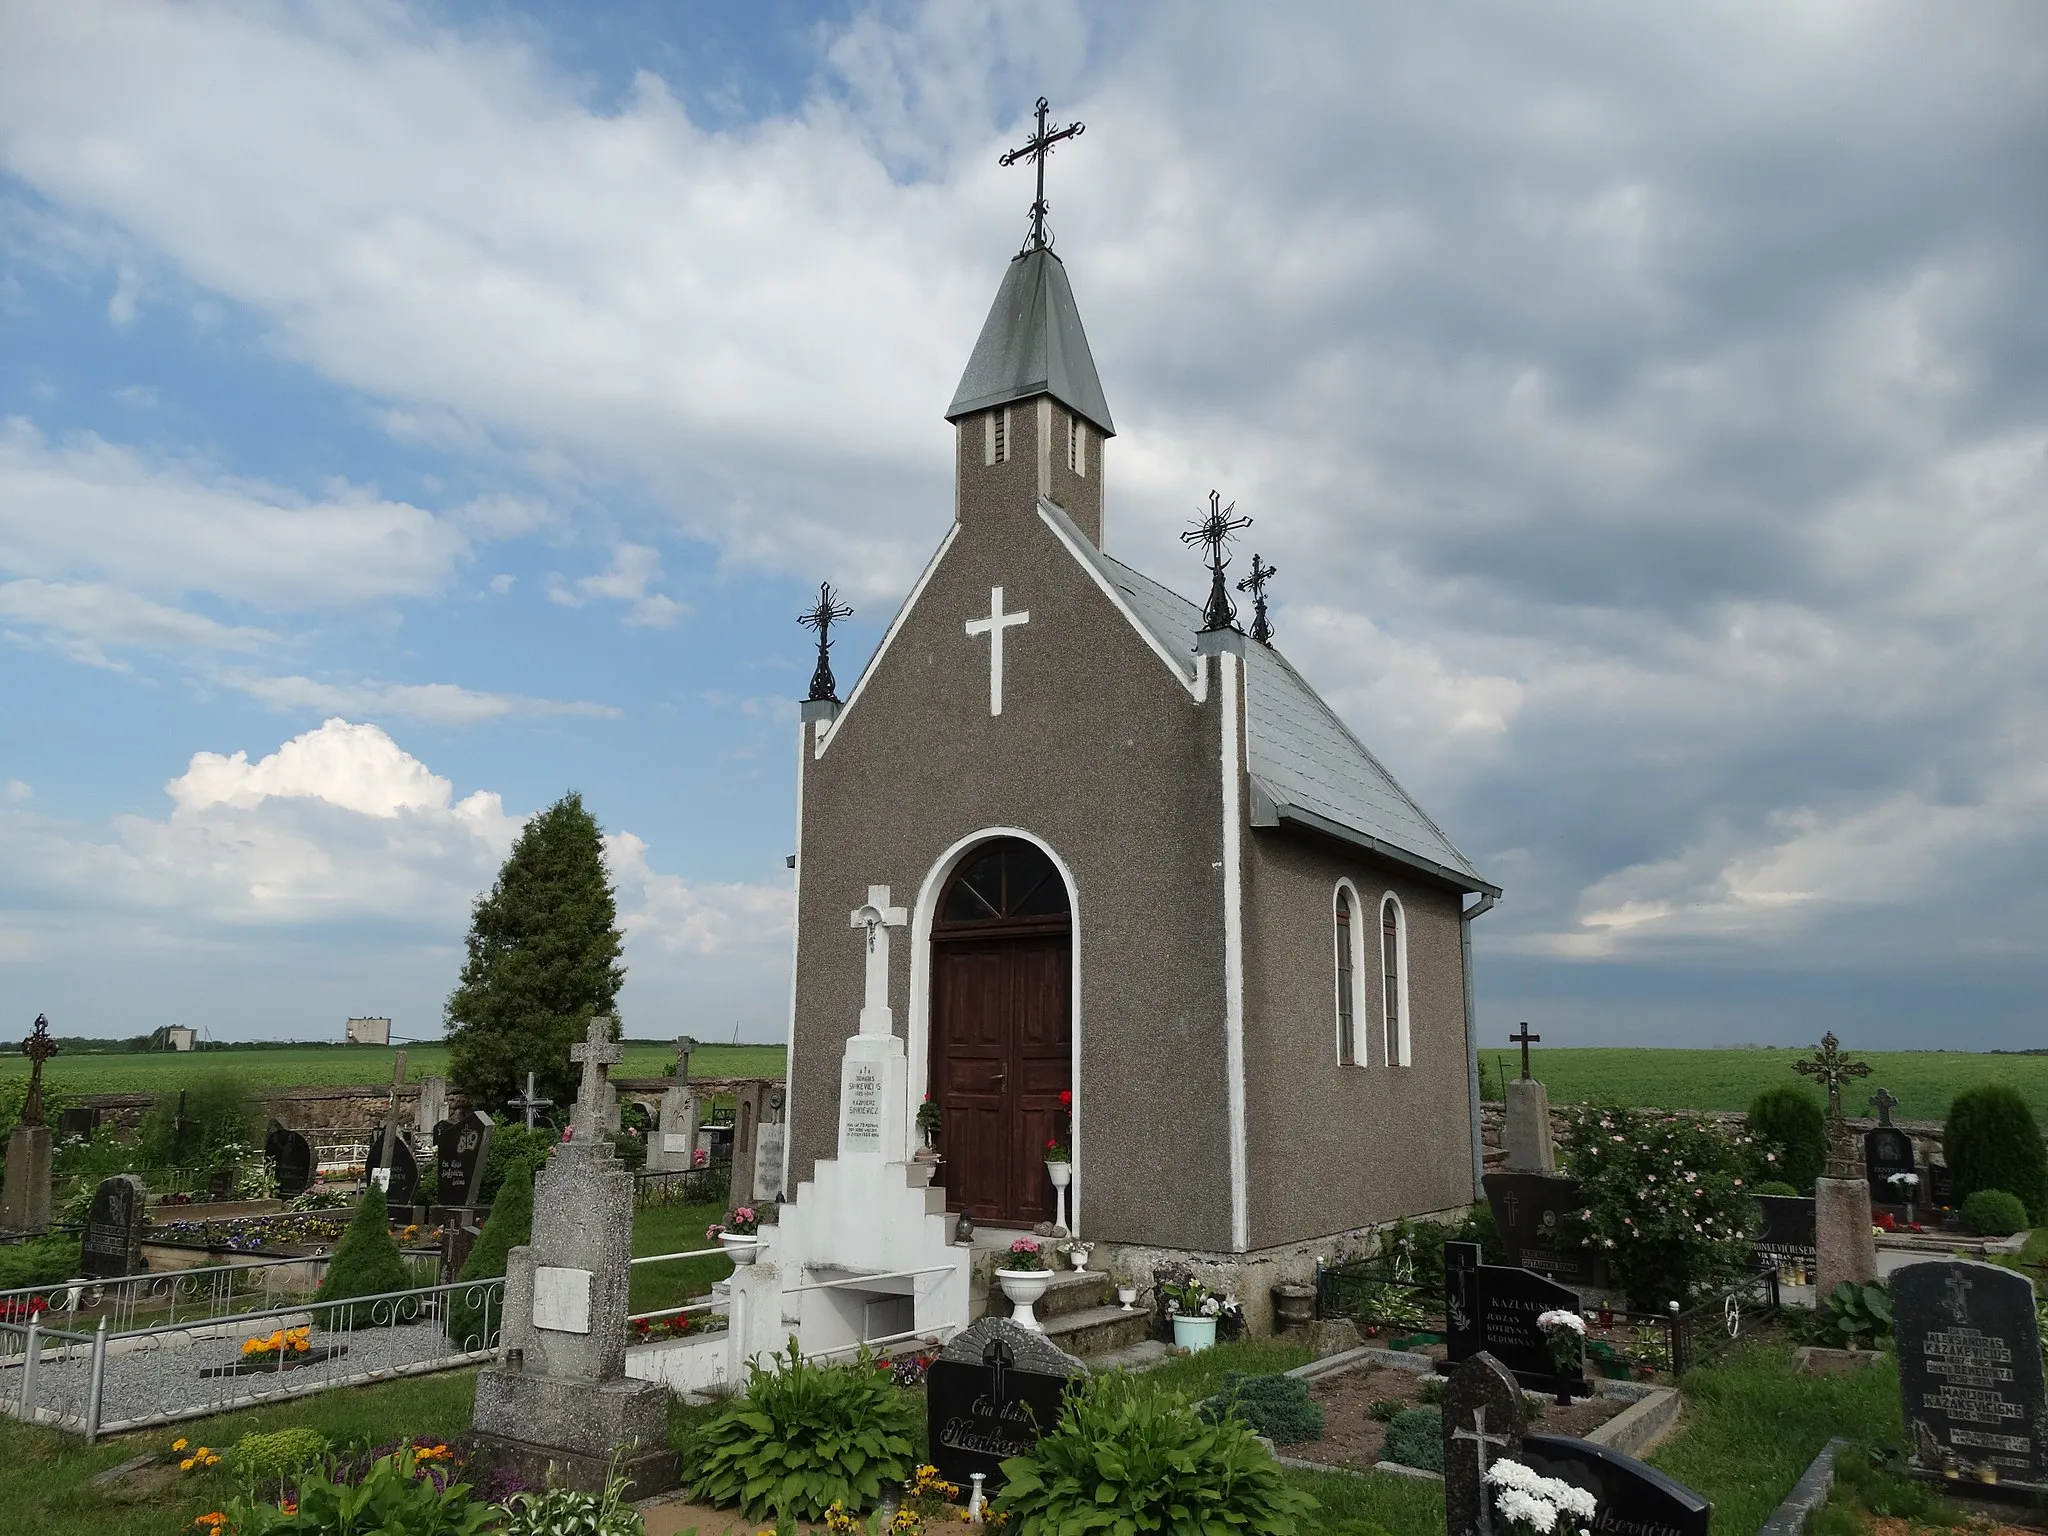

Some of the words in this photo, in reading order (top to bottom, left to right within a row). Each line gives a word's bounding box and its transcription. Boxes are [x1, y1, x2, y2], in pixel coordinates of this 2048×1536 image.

[1487, 1324, 1529, 1336] KOTRYNA
[1928, 1333, 2003, 1349] ALEKSANDRAS
[971, 1394, 994, 1417] Čia
